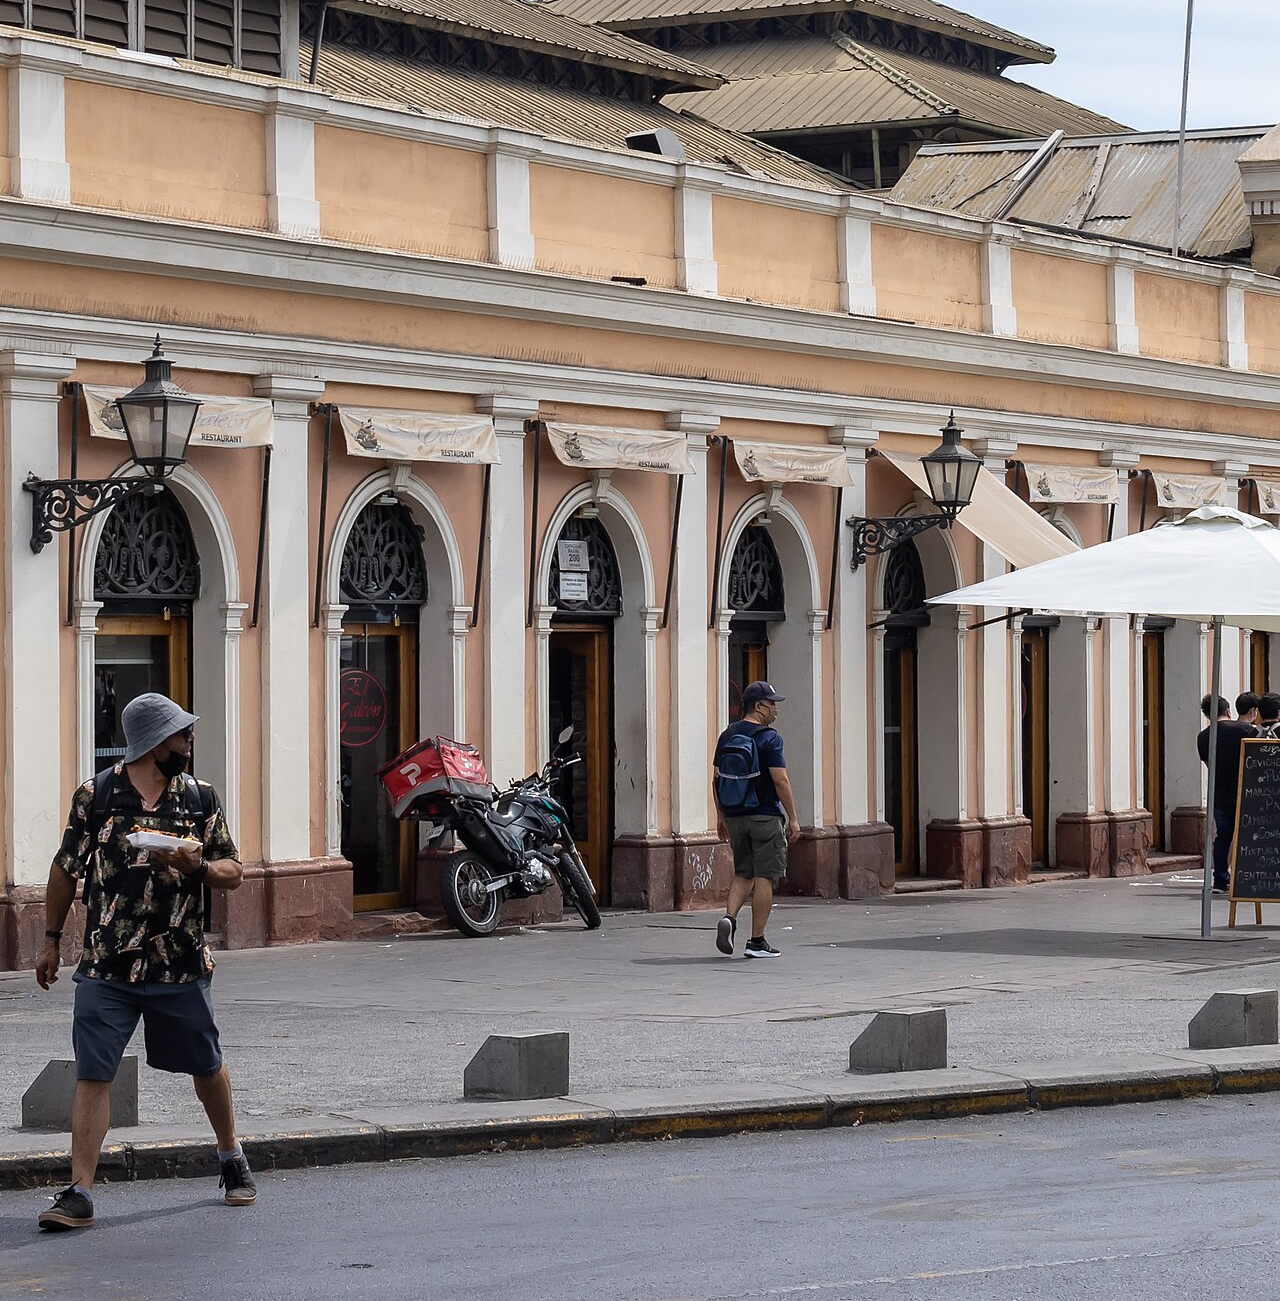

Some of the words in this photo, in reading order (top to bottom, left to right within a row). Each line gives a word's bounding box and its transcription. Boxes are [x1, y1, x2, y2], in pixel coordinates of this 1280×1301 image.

[194, 408, 251, 430] aleón
[201, 432, 243, 443] RESTAURANT
[440, 449, 476, 458] RESTAURANT
[637, 460, 670, 469] RESTAURANT
[568, 553, 581, 562] 200
[1237, 869, 1280, 884] CENTOLLA
